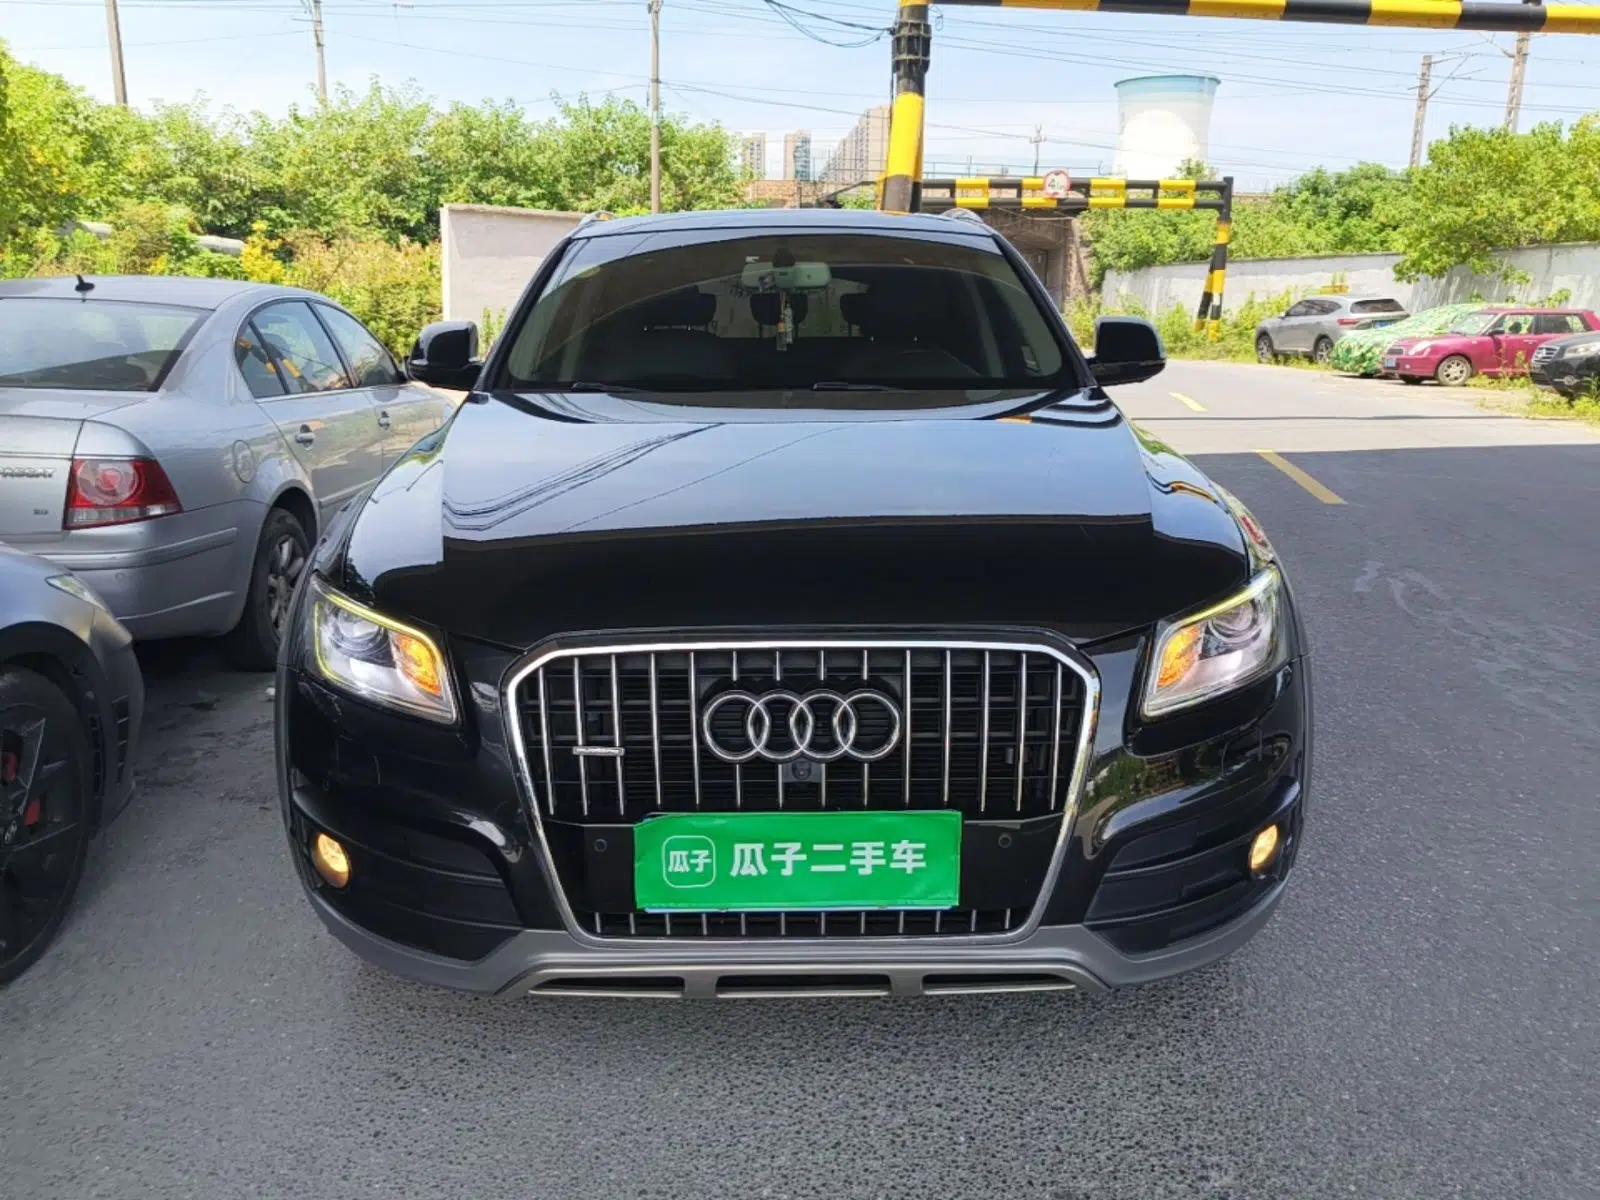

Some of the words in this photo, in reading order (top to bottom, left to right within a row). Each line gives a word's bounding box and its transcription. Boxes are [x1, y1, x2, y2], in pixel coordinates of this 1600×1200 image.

[668, 849, 712, 873] 瓜子
[730, 840, 927, 877] 瓜子二手车
